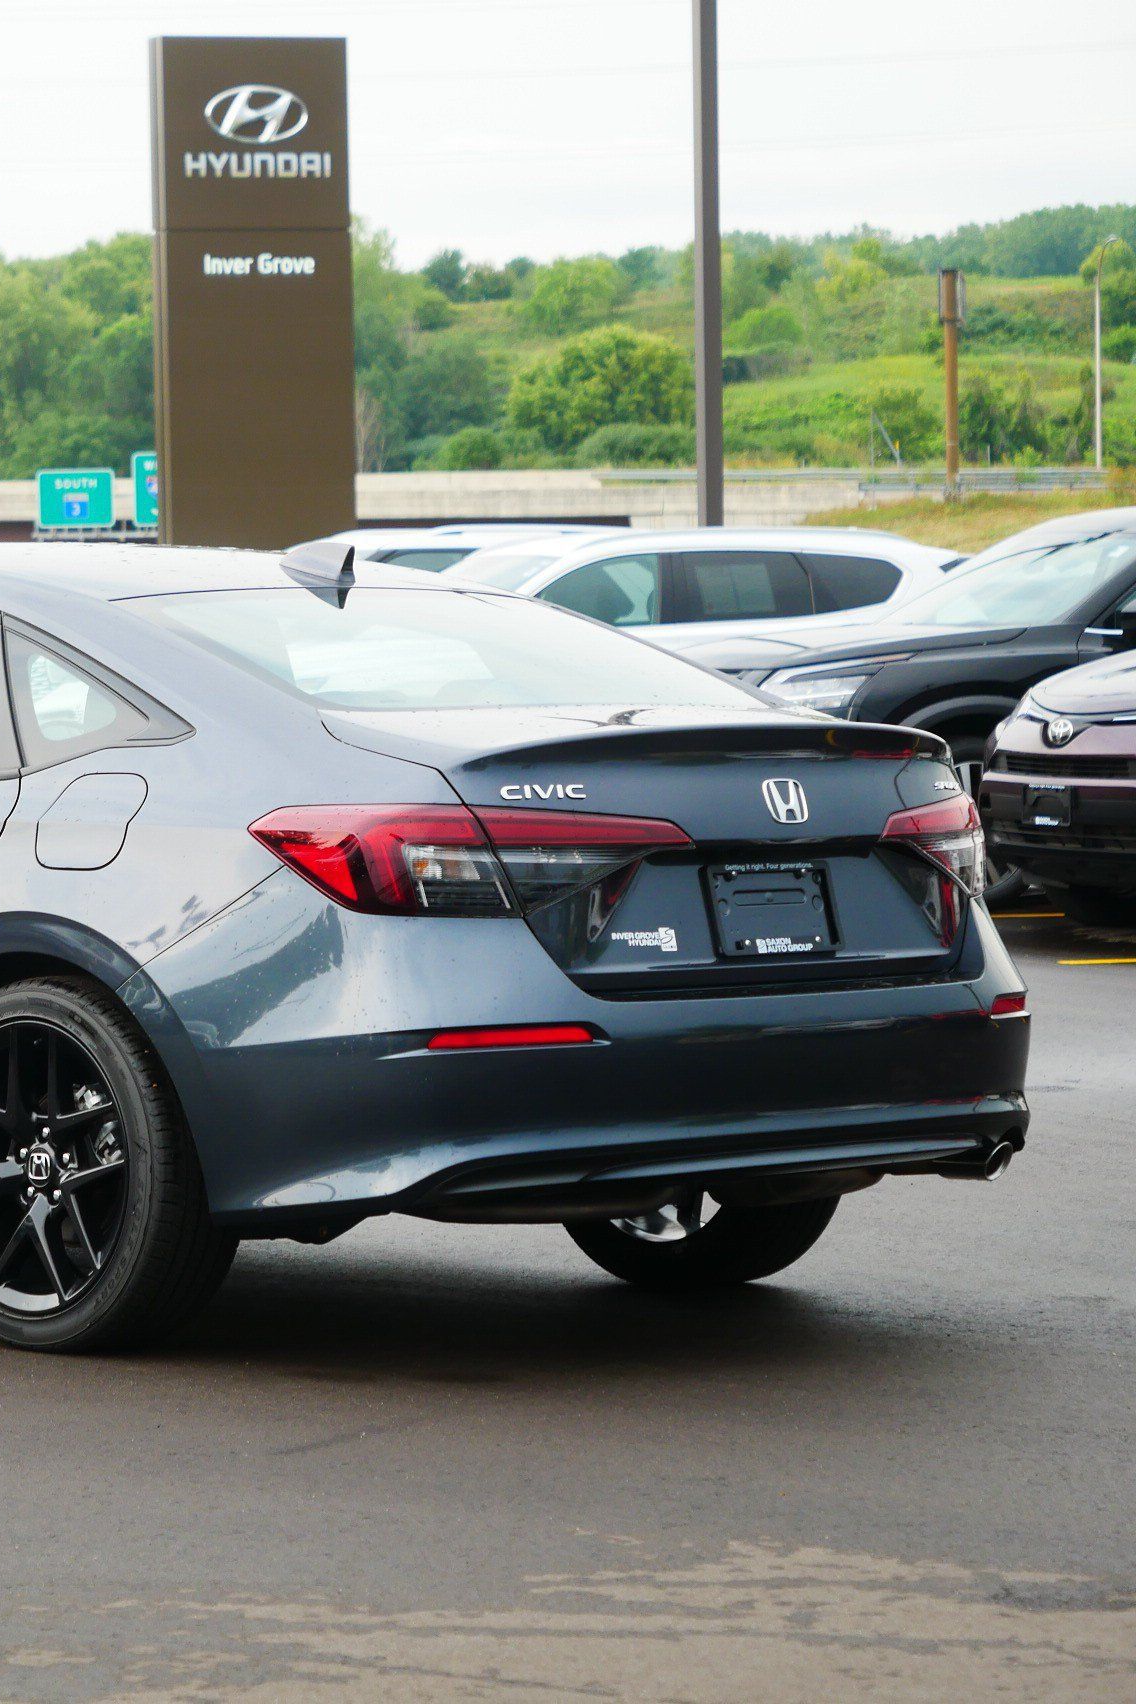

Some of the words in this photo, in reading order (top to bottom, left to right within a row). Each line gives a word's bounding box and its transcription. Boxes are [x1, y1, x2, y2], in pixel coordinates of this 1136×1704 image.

[184, 152, 332, 178] HYUNDAI
[203, 252, 254, 275] Inver
[257, 252, 315, 275] Grove
[54, 477, 98, 489] SOUTH
[500, 784, 587, 800] CIVIC
[766, 862, 779, 870] Four
[780, 862, 813, 870] generations.
[611, 932, 634, 940] INVER
[635, 932, 660, 940] GROVE
[767, 945, 788, 953] AUTO
[788, 942, 814, 952] GROUP
